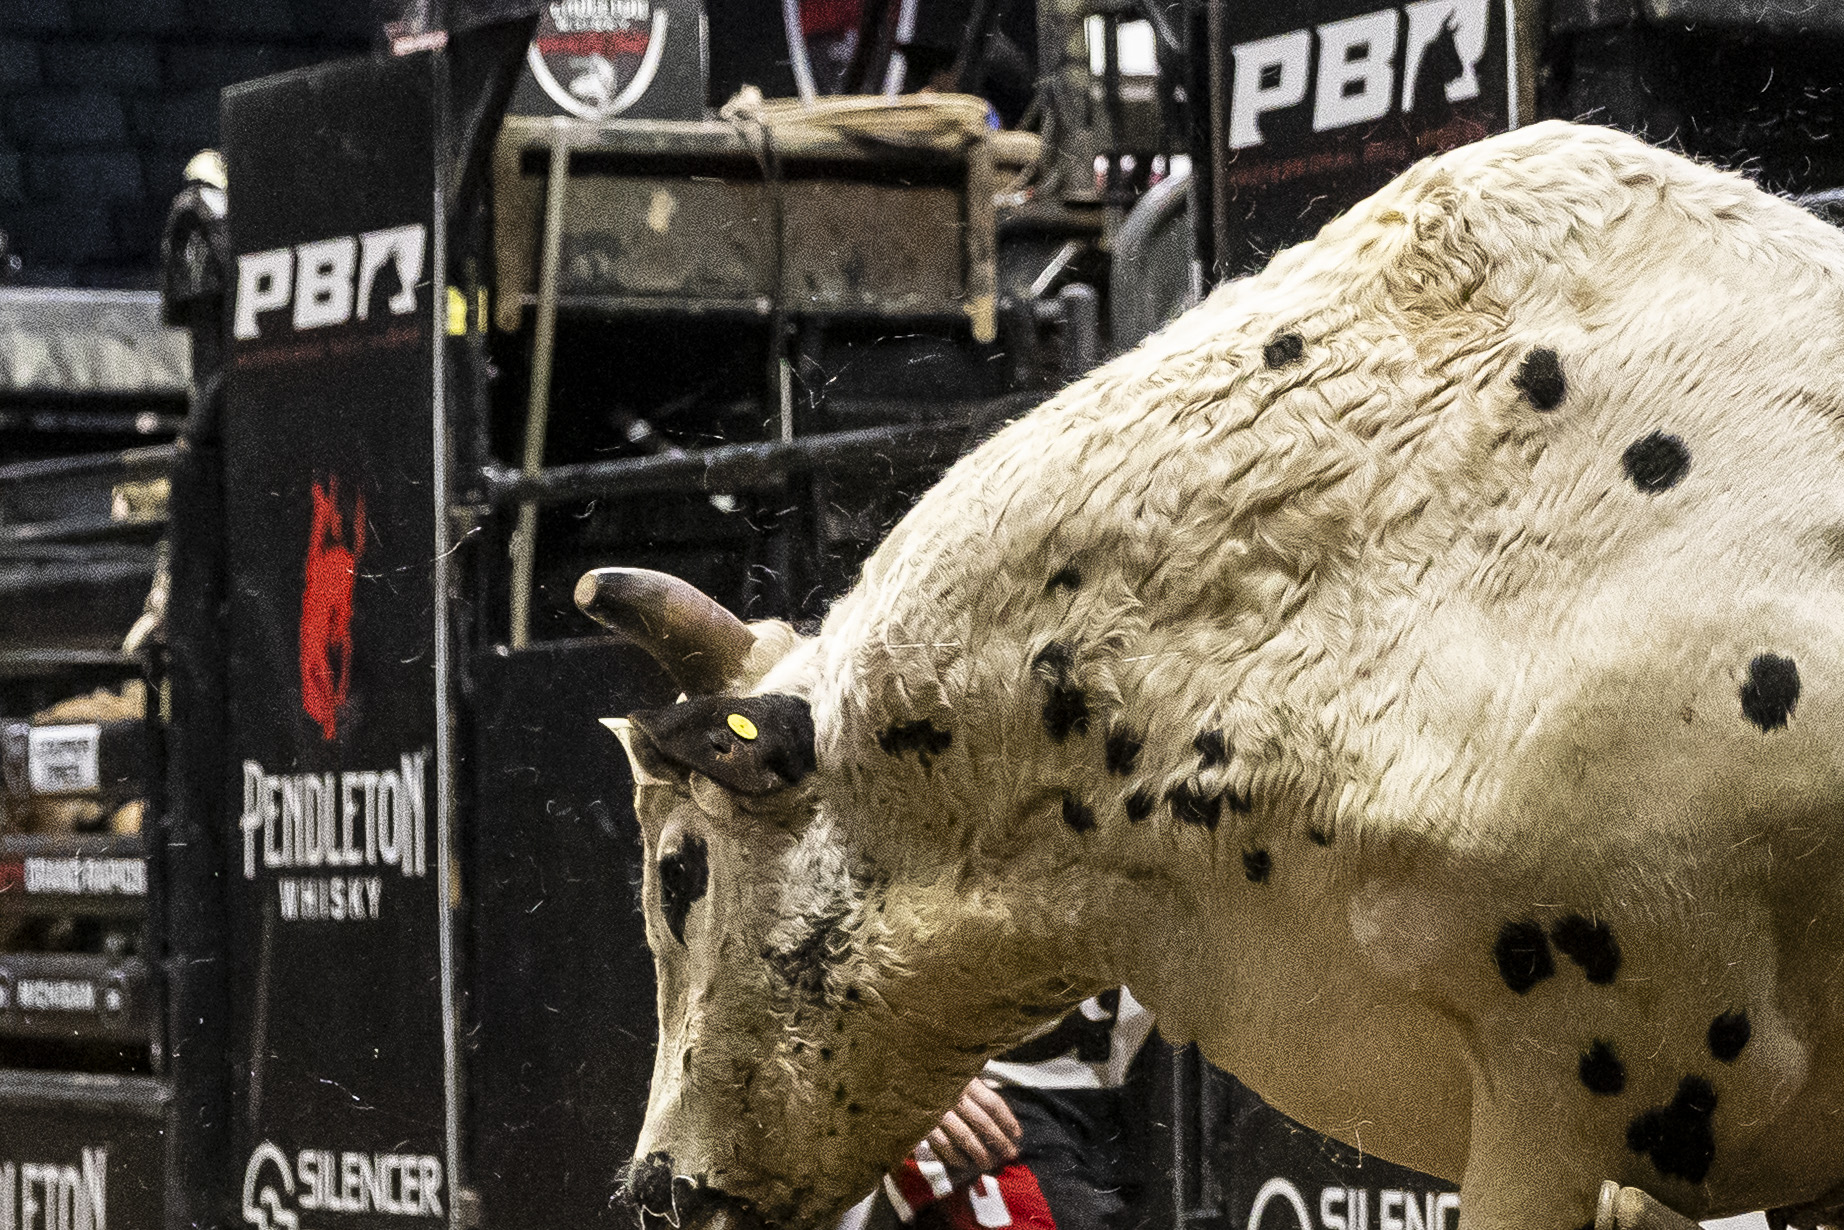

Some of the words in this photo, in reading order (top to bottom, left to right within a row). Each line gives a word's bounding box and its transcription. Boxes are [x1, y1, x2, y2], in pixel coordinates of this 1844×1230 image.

[240, 753, 428, 880] PENDLETON
[278, 876, 383, 921] WHISKY
[297, 1148, 445, 1218] SILENCER
